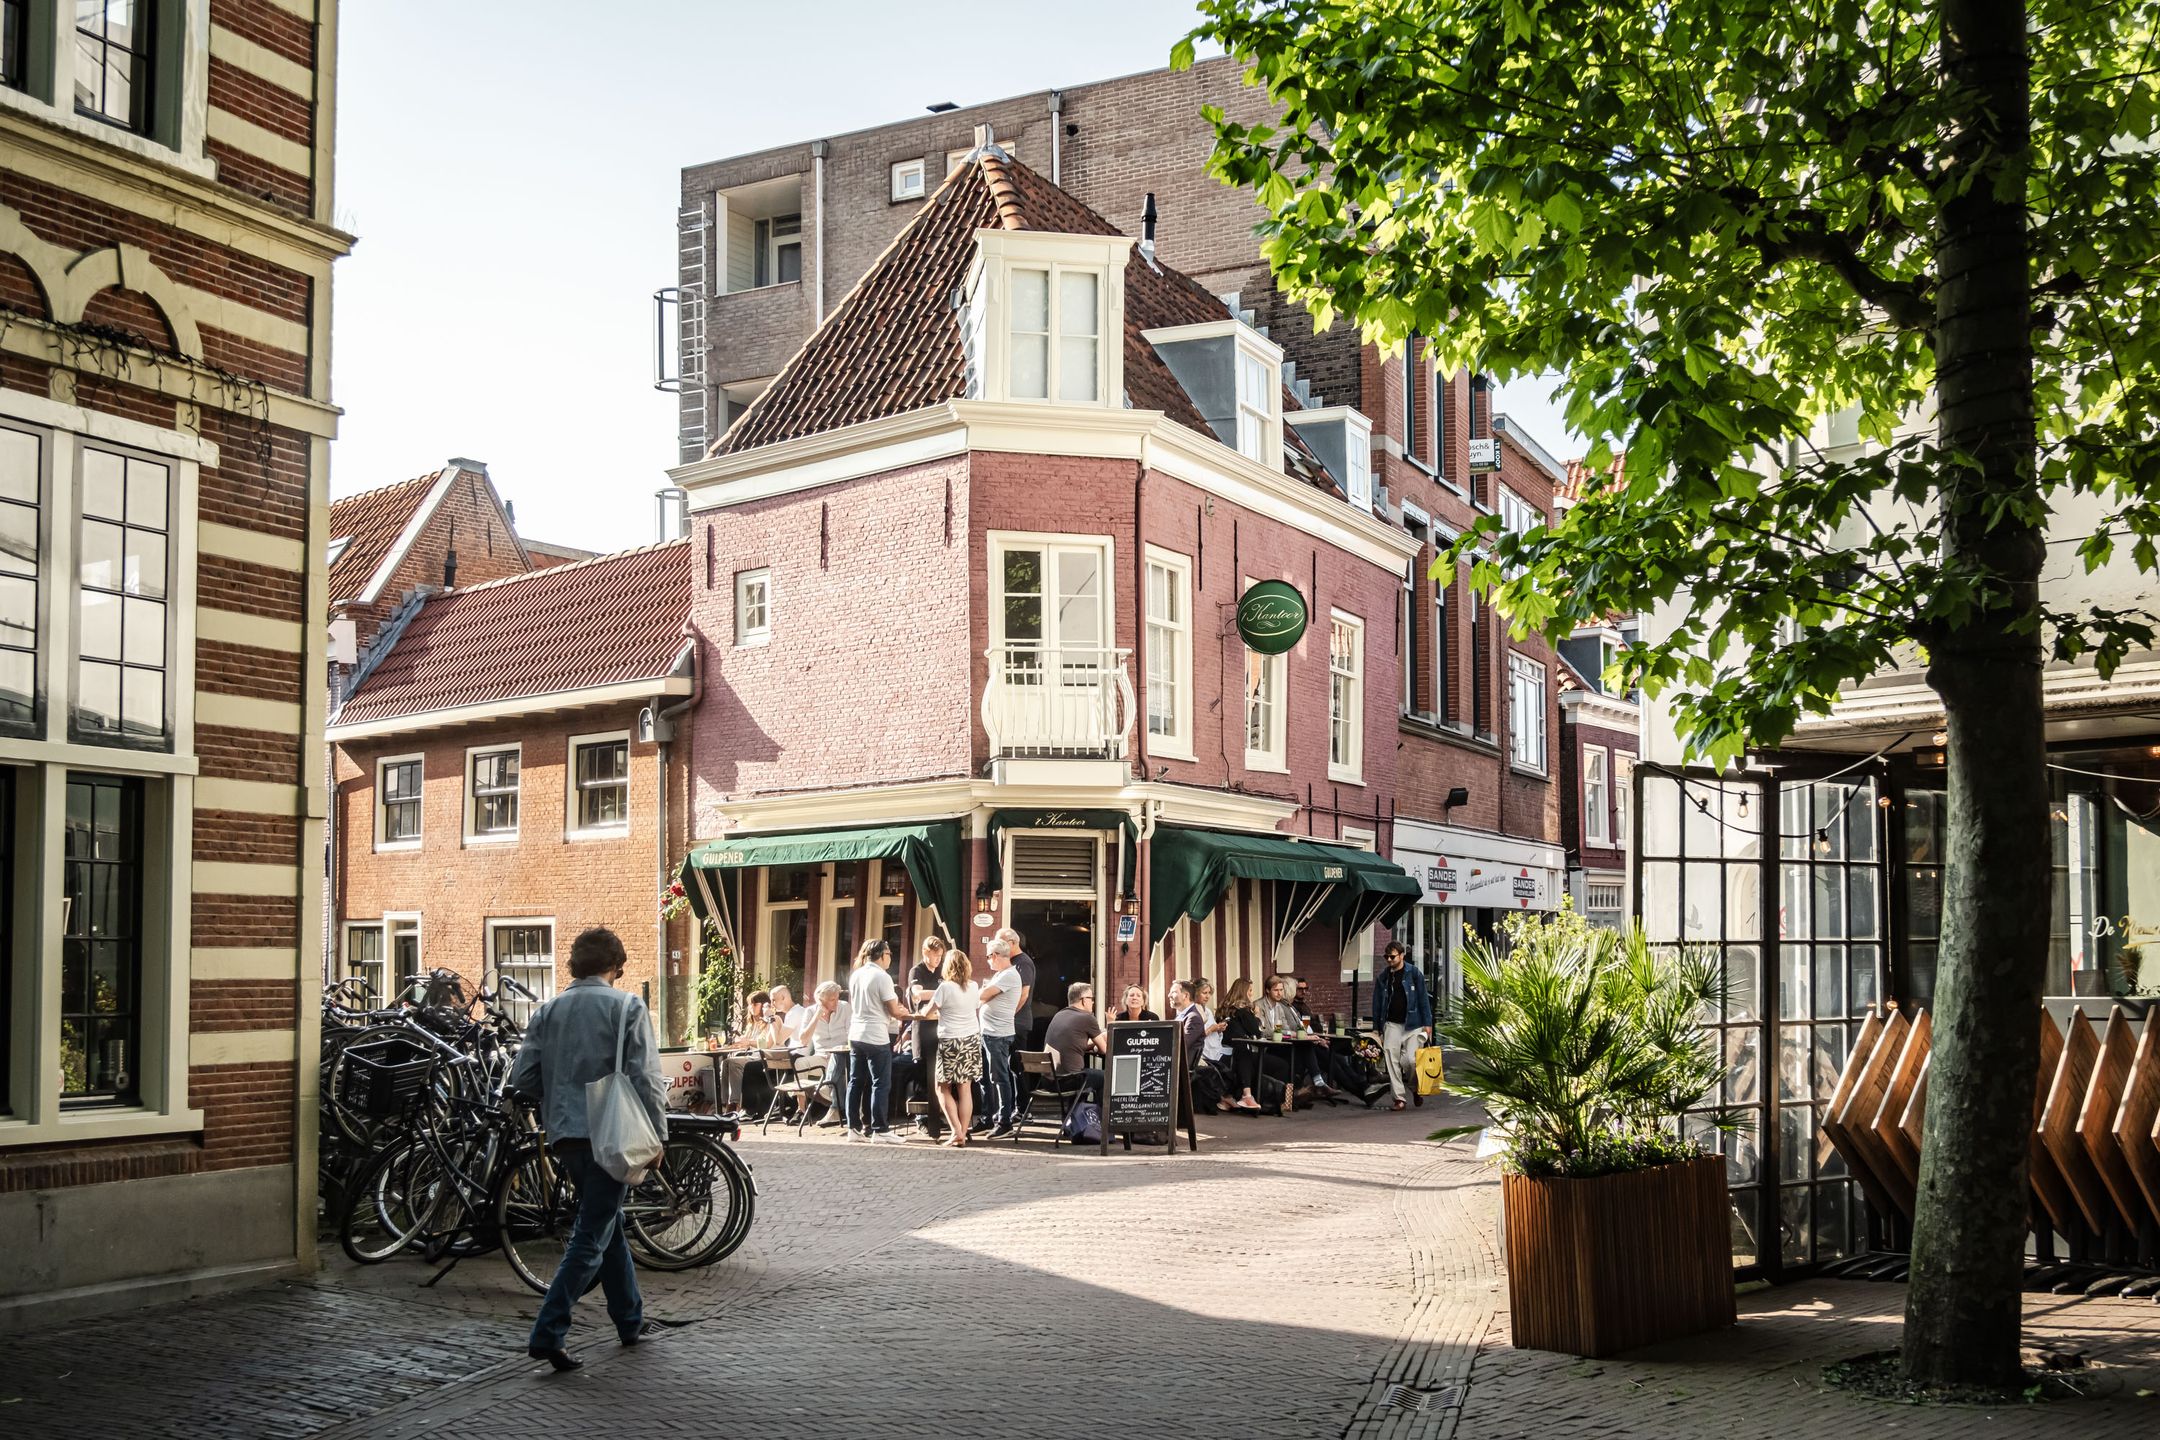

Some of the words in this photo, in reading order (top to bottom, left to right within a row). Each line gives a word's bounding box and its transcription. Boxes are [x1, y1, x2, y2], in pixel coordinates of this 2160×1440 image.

[1246, 602, 1301, 622] Kantoor
[1041, 811, 1086, 826] Kantoor
[702, 851, 744, 866] GULPENER
[1428, 870, 1457, 883] SANDER
[1513, 877, 1536, 891] SANDER
[2087, 915, 2116, 938] De
[1126, 1038, 1160, 1046] GULPENER
